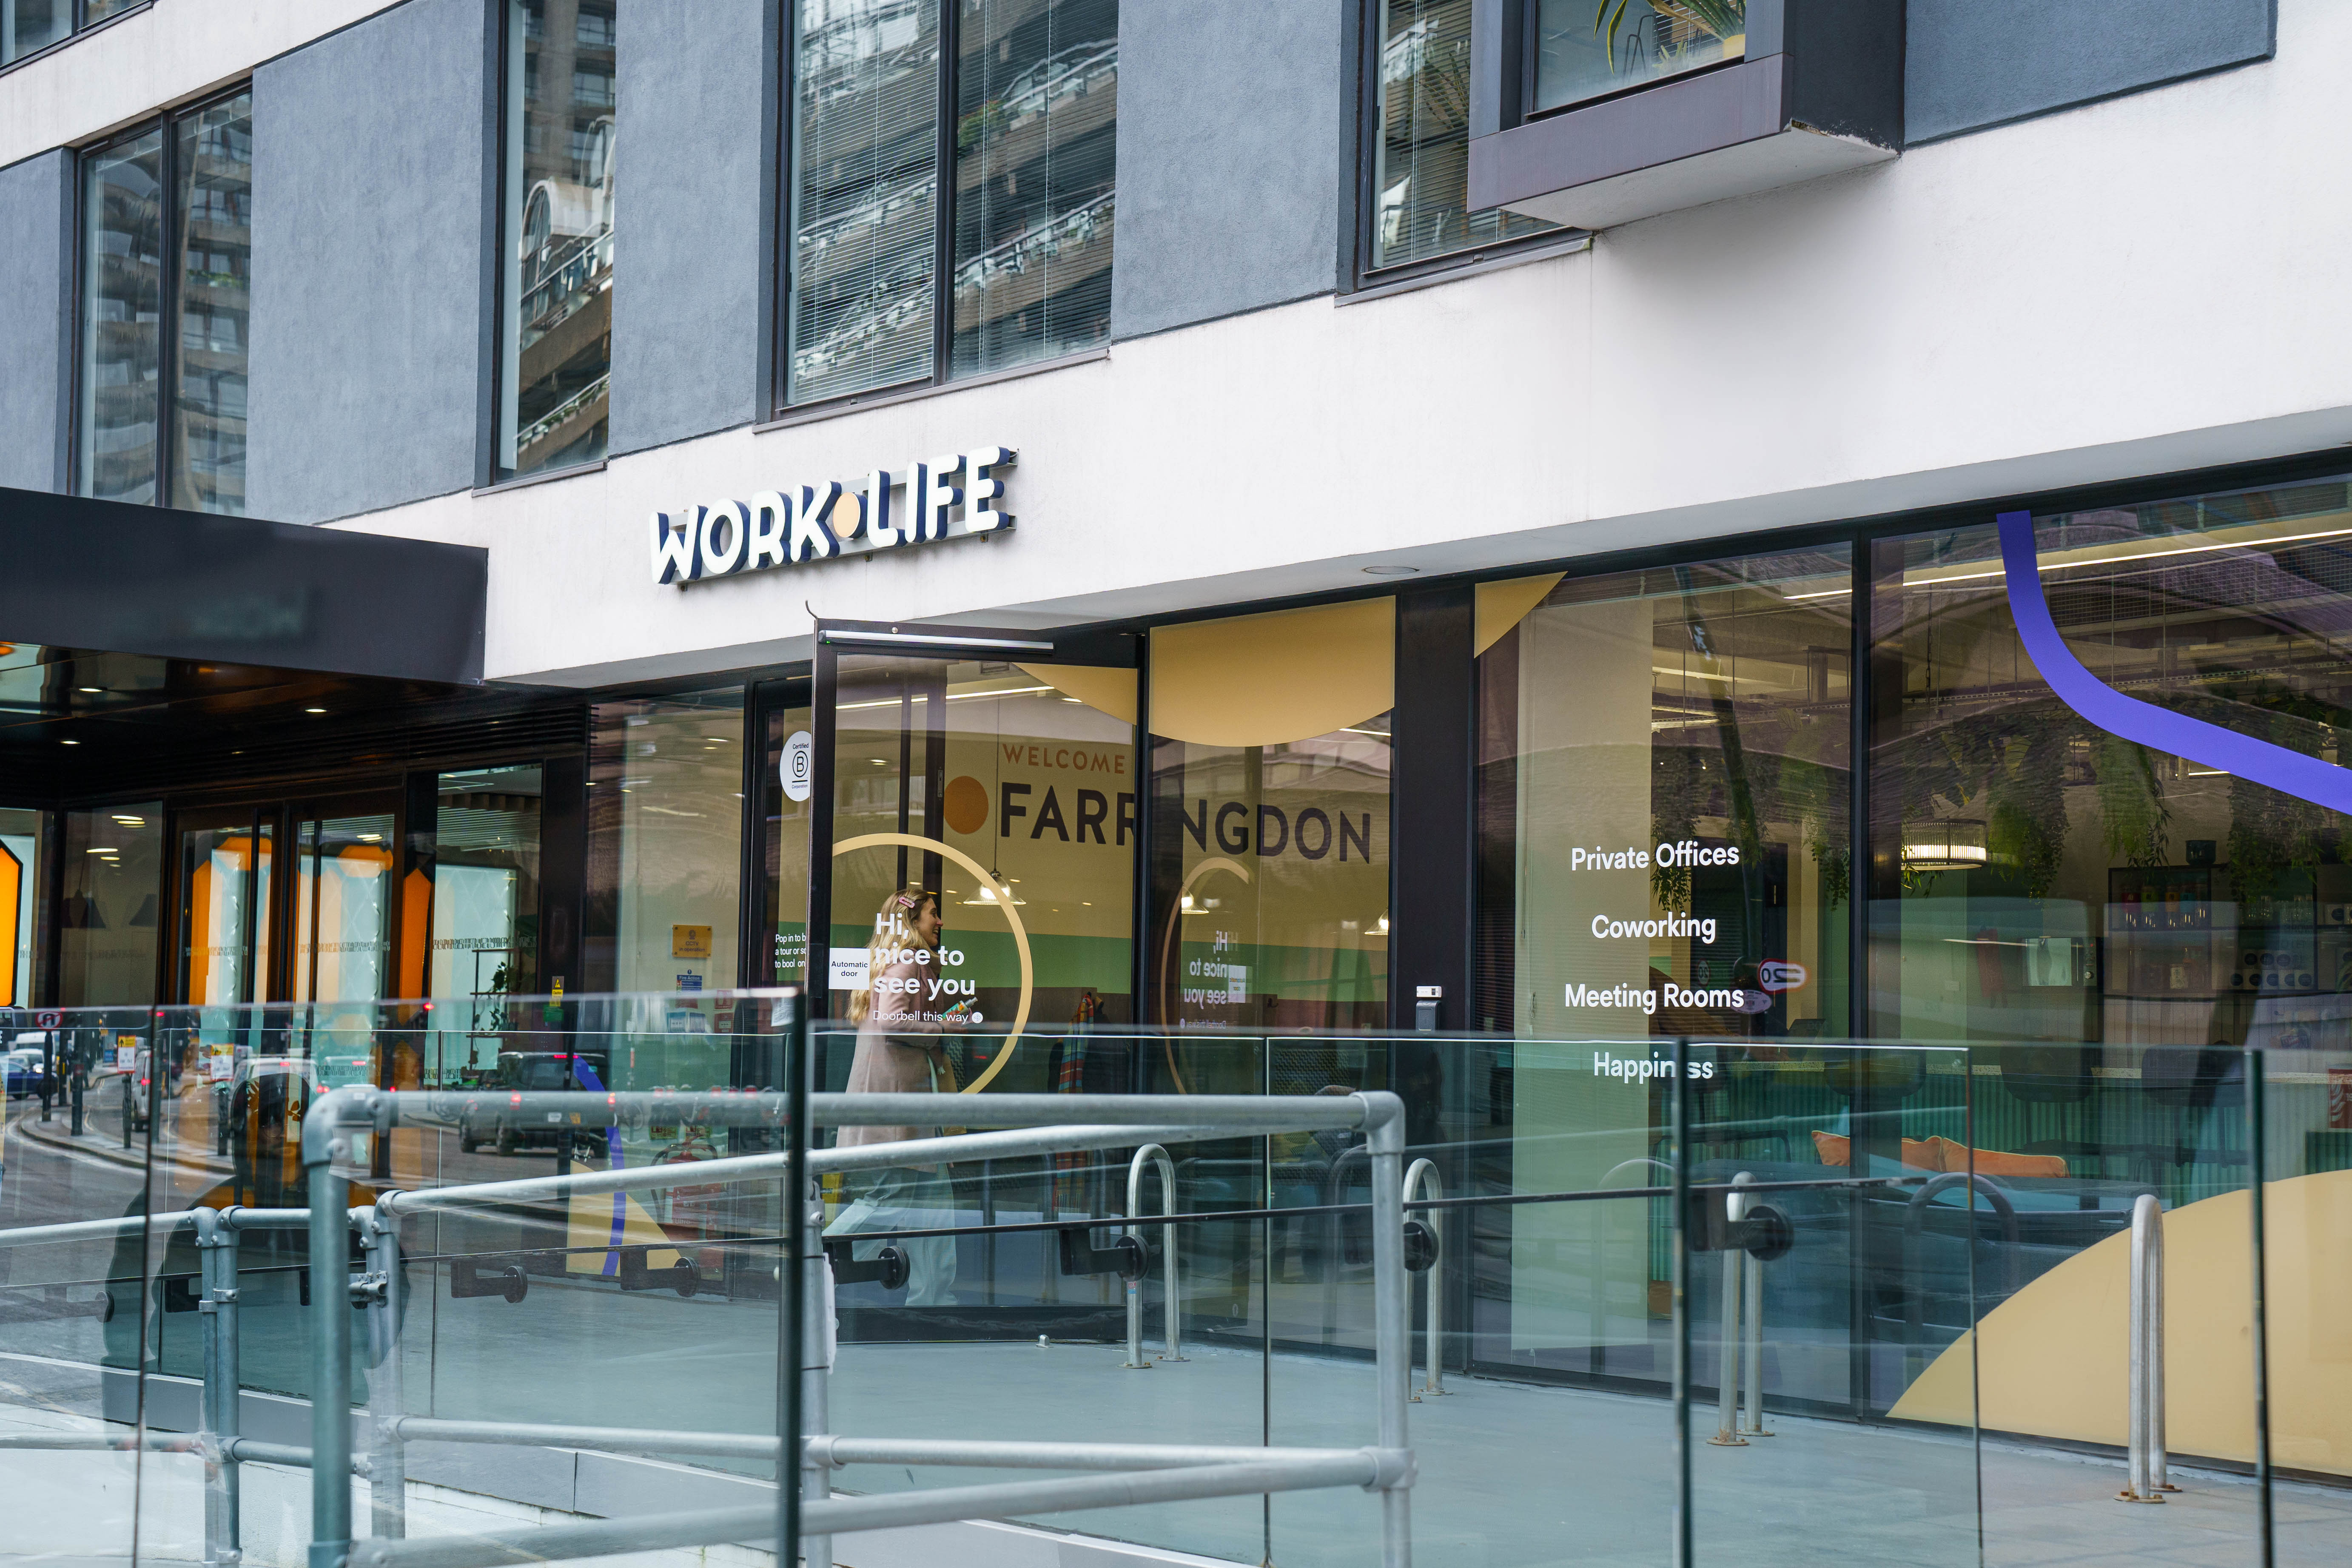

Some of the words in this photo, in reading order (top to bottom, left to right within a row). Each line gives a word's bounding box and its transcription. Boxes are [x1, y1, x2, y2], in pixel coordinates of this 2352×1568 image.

[649, 480, 841, 584] WORK
[867, 446, 1011, 548] LIFE
[1003, 743, 1125, 774] WELCOME
[1001, 782, 1370, 864] FARRNGDON
[1571, 846, 1649, 871] Private
[1656, 840, 1740, 868] Offices
[775, 934, 787, 945] Pop
[788, 933, 794, 942] in
[794, 934, 800, 942] to
[876, 913, 909, 939] Hi,
[1591, 912, 1716, 944] Coworking
[875, 942, 931, 965] nice
[938, 945, 965, 966] to
[874, 978, 920, 994] see
[927, 979, 975, 1001] you
[1565, 983, 1656, 1015] Meeting
[1663, 983, 1744, 1008] Rooms
[873, 1010, 920, 1021] Doorbell
[923, 1011, 943, 1021] this
[946, 1014, 969, 1024] way
[1594, 1051, 1713, 1084] Happinss
